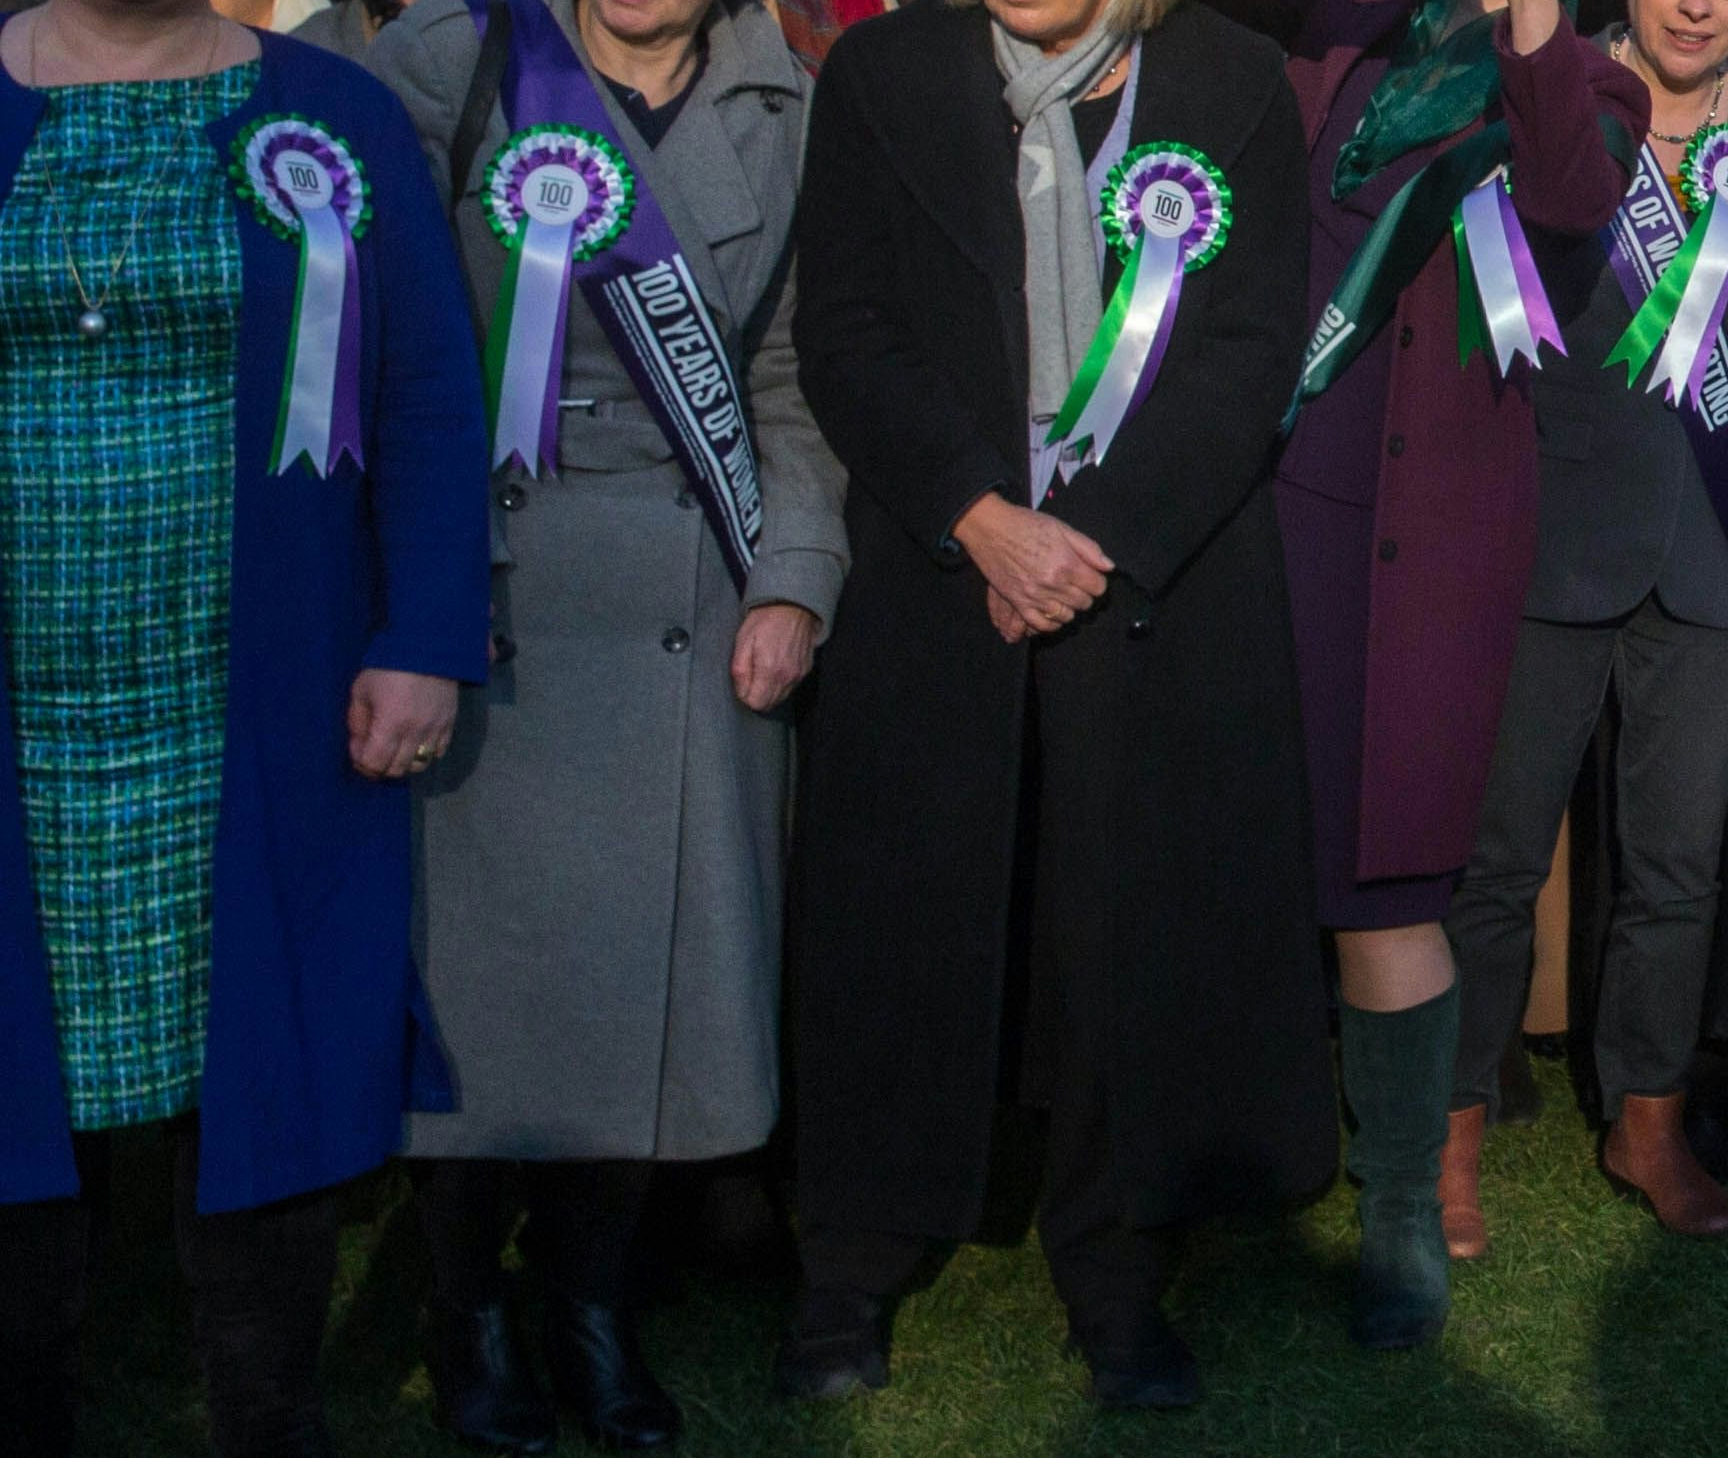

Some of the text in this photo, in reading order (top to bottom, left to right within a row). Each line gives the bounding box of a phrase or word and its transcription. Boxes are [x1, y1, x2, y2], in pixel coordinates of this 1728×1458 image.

[288, 166, 319, 190] 100
[540, 181, 573, 206] 100
[1154, 193, 1182, 222] 100
[1629, 196, 1671, 230] OF
[632, 259, 687, 317] 100
[659, 313, 729, 409] YEARS
[703, 399, 741, 442] OF
[723, 435, 763, 540] WOMEN
